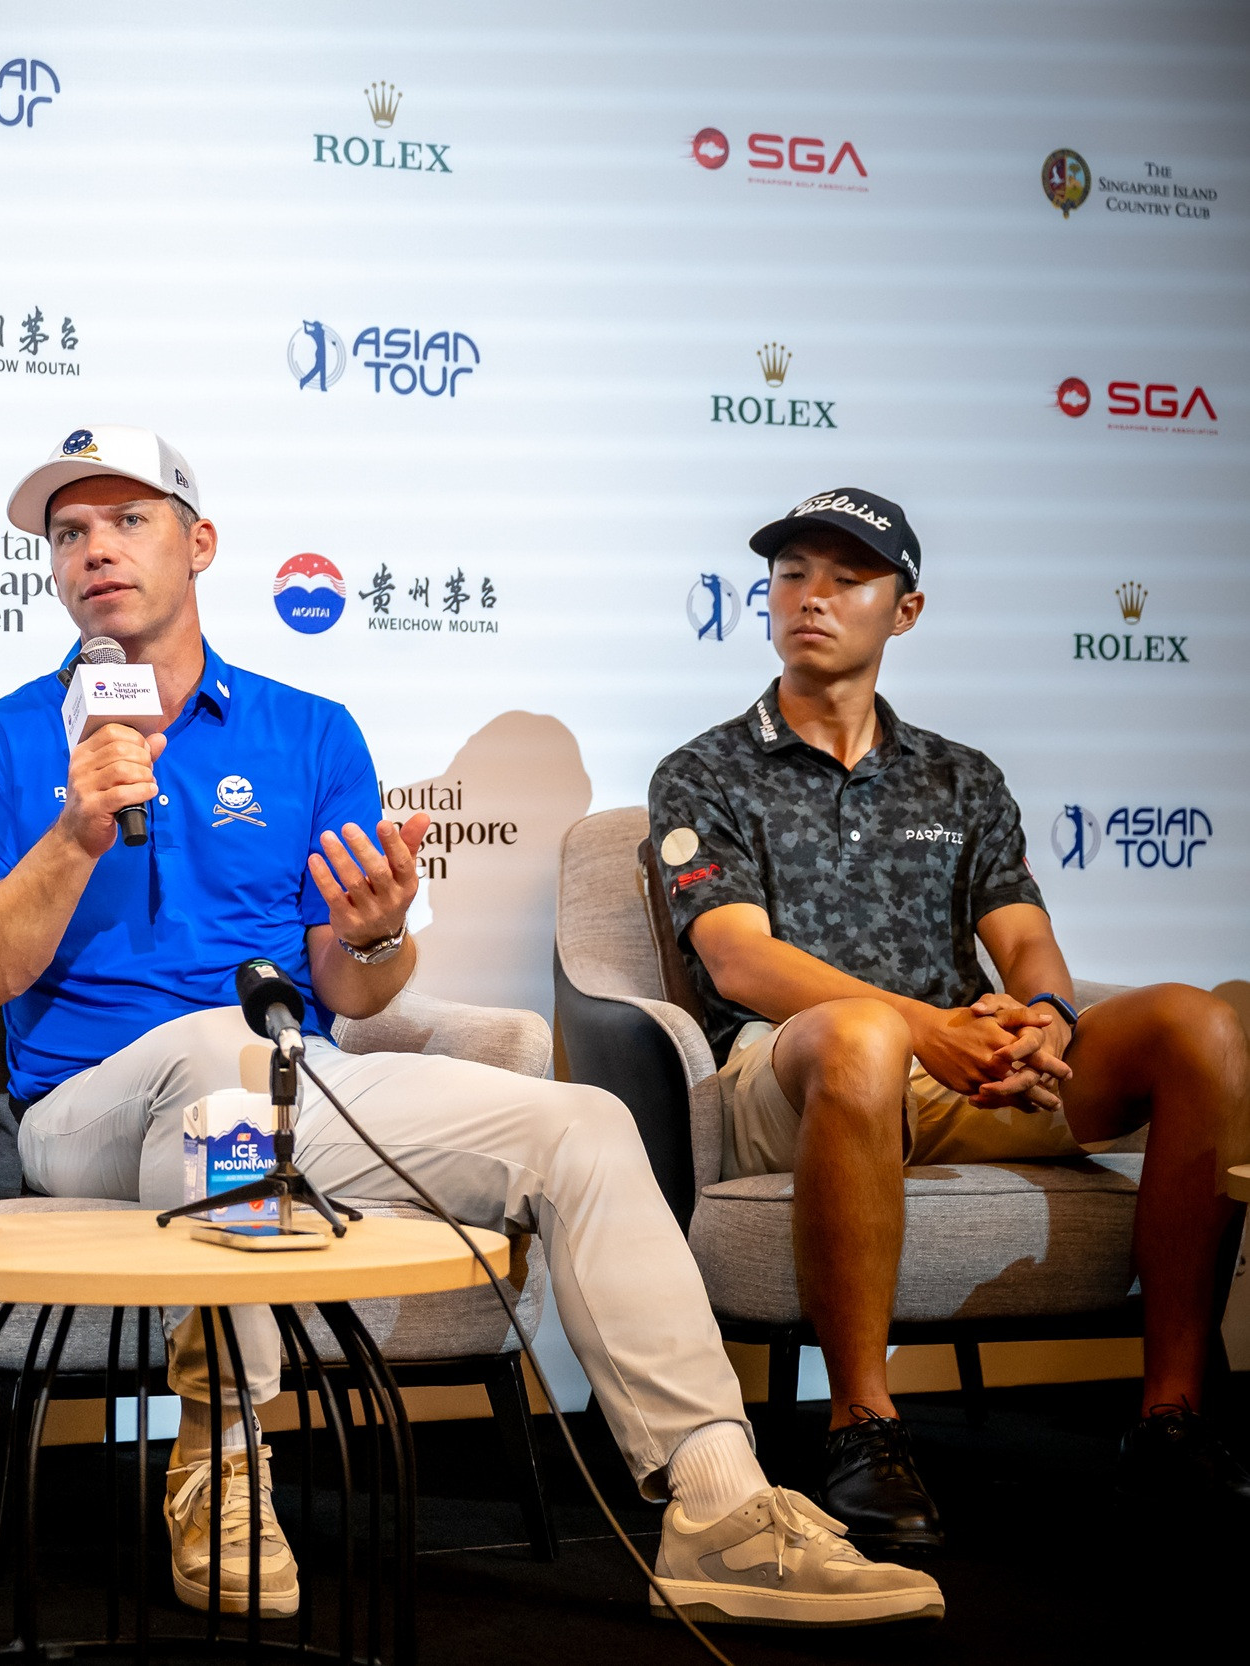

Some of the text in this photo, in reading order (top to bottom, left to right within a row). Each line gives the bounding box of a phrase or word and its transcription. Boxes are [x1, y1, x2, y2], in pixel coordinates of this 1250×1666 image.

[313, 133, 453, 174] ROLEX
[748, 133, 868, 178] SGA
[352, 326, 480, 364] ASIAN
[26, 361, 80, 376] MOUTAI
[364, 361, 473, 398] TOUR
[711, 395, 837, 429] ROLEX
[1108, 381, 1217, 421] SGA
[794, 492, 892, 531] Titleist
[292, 606, 330, 618] MOUTAI
[368, 617, 498, 633] KWEICHOW MOUTAI
[1073, 632, 1190, 663] ROLEX
[1106, 807, 1213, 836] ASIAN
[1116, 839, 1206, 869] TOUR
[214, 1158, 276, 1171] MOUNTAIN
[231, 1144, 258, 1158] ICE
